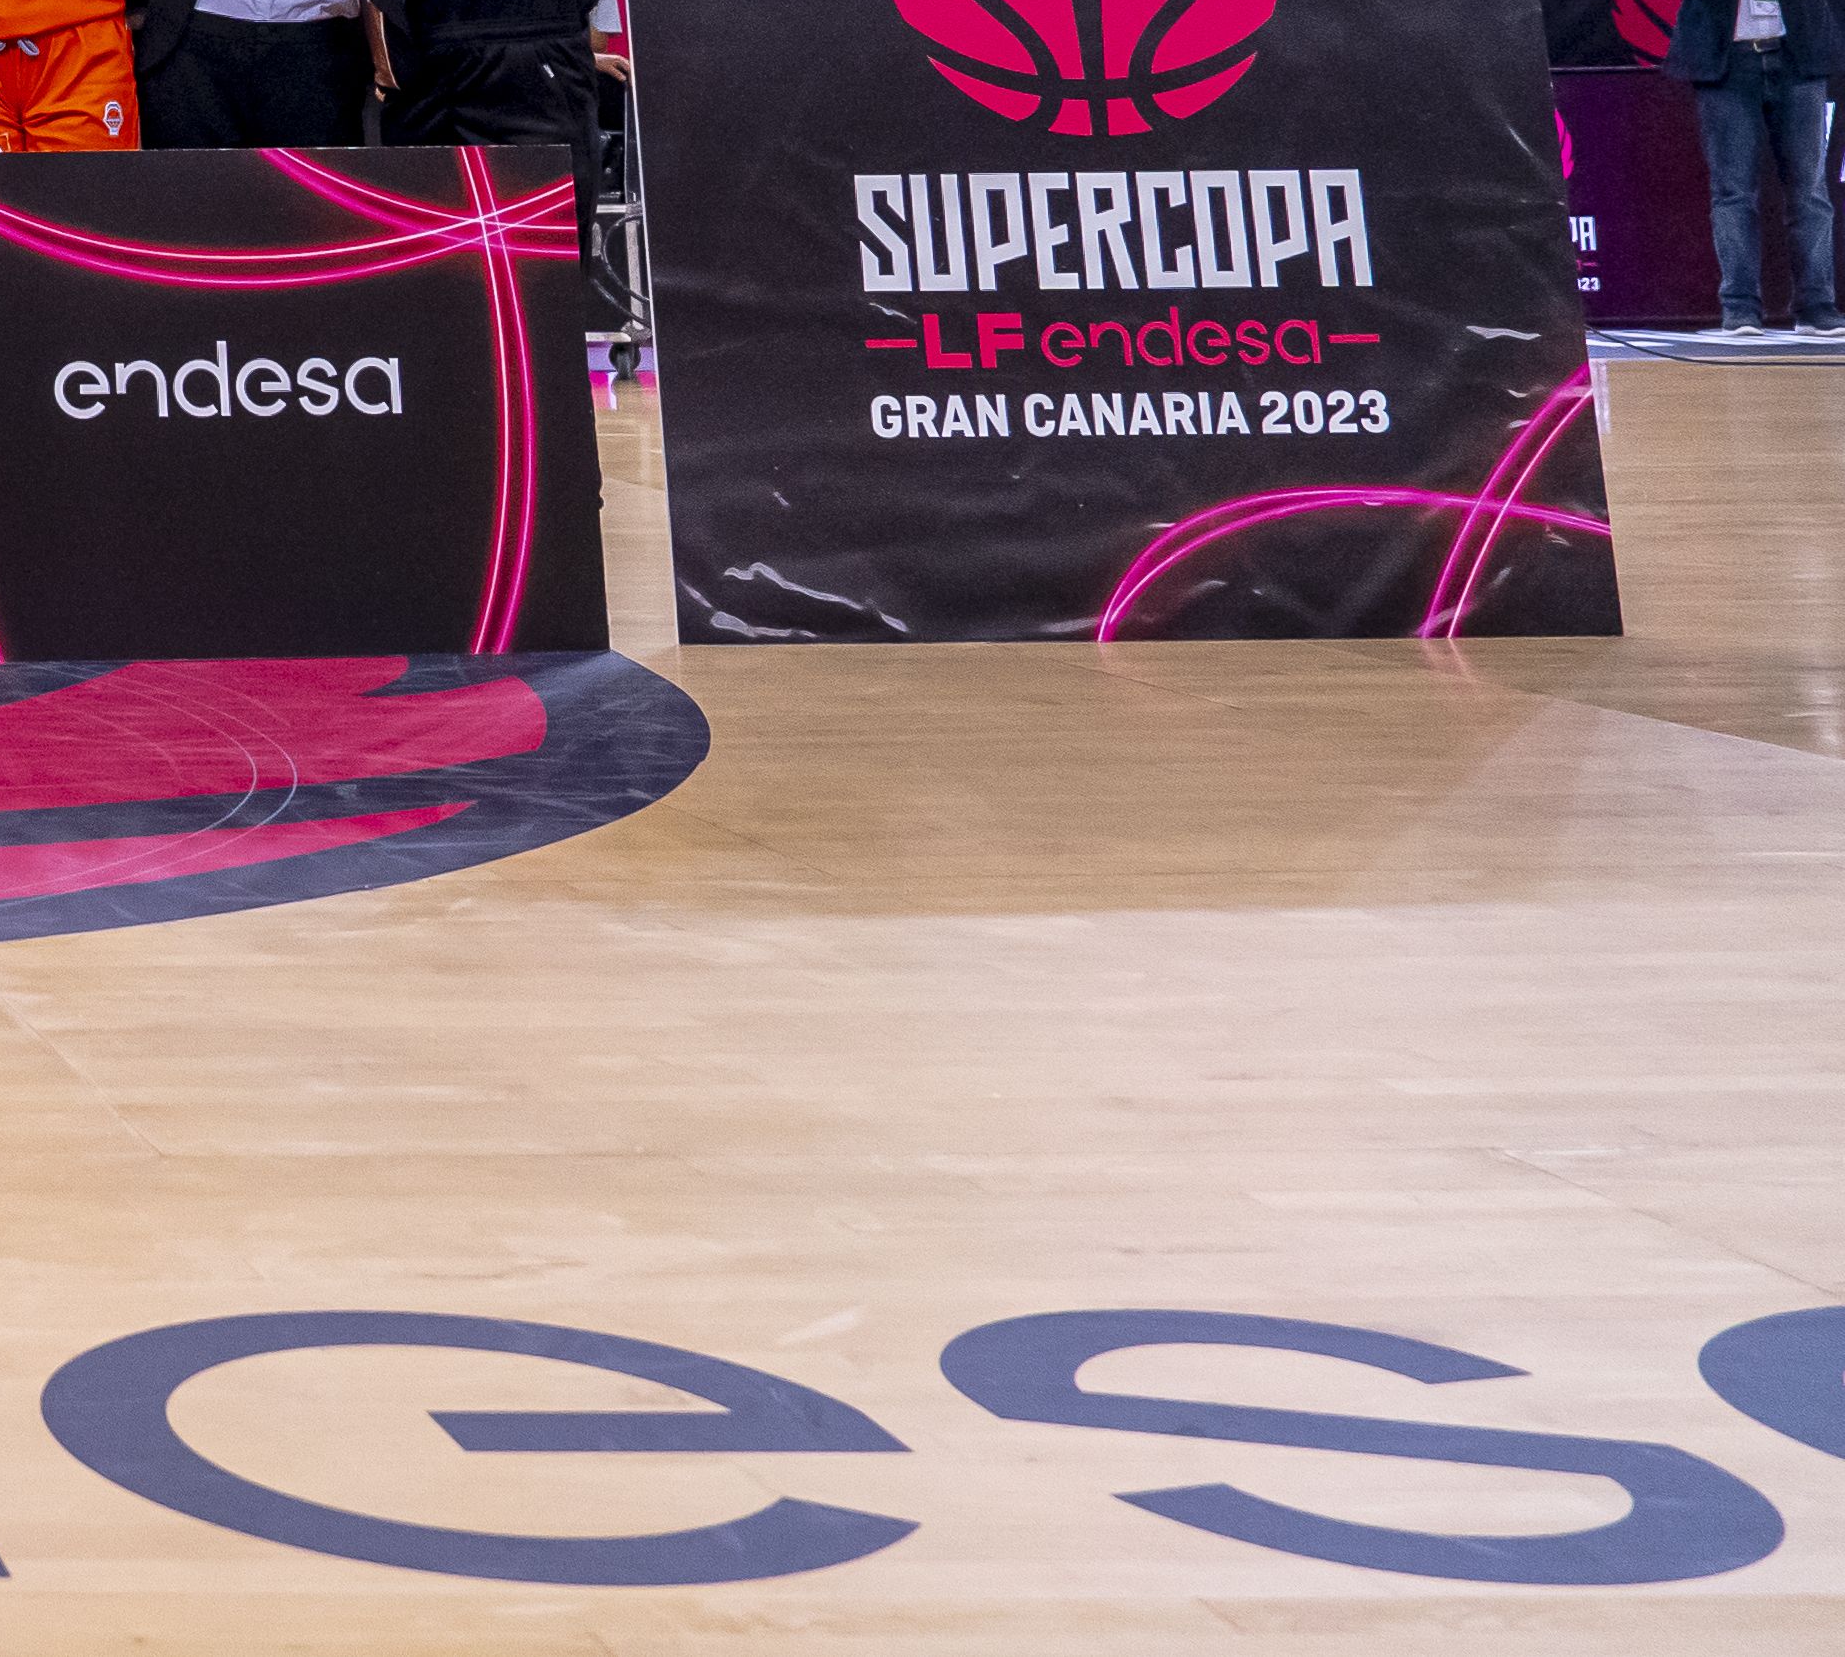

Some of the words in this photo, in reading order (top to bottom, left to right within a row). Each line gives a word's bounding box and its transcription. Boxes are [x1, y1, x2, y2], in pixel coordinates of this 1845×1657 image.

[854, 168, 1374, 292] SUPERCOPA
[922, 312, 1024, 369] LF
[1041, 306, 1322, 368] endesa
[54, 340, 403, 420] endesa
[870, 394, 1009, 439] GRAN
[1024, 391, 1251, 437] CANARIA
[1261, 389, 1391, 435] 2023
